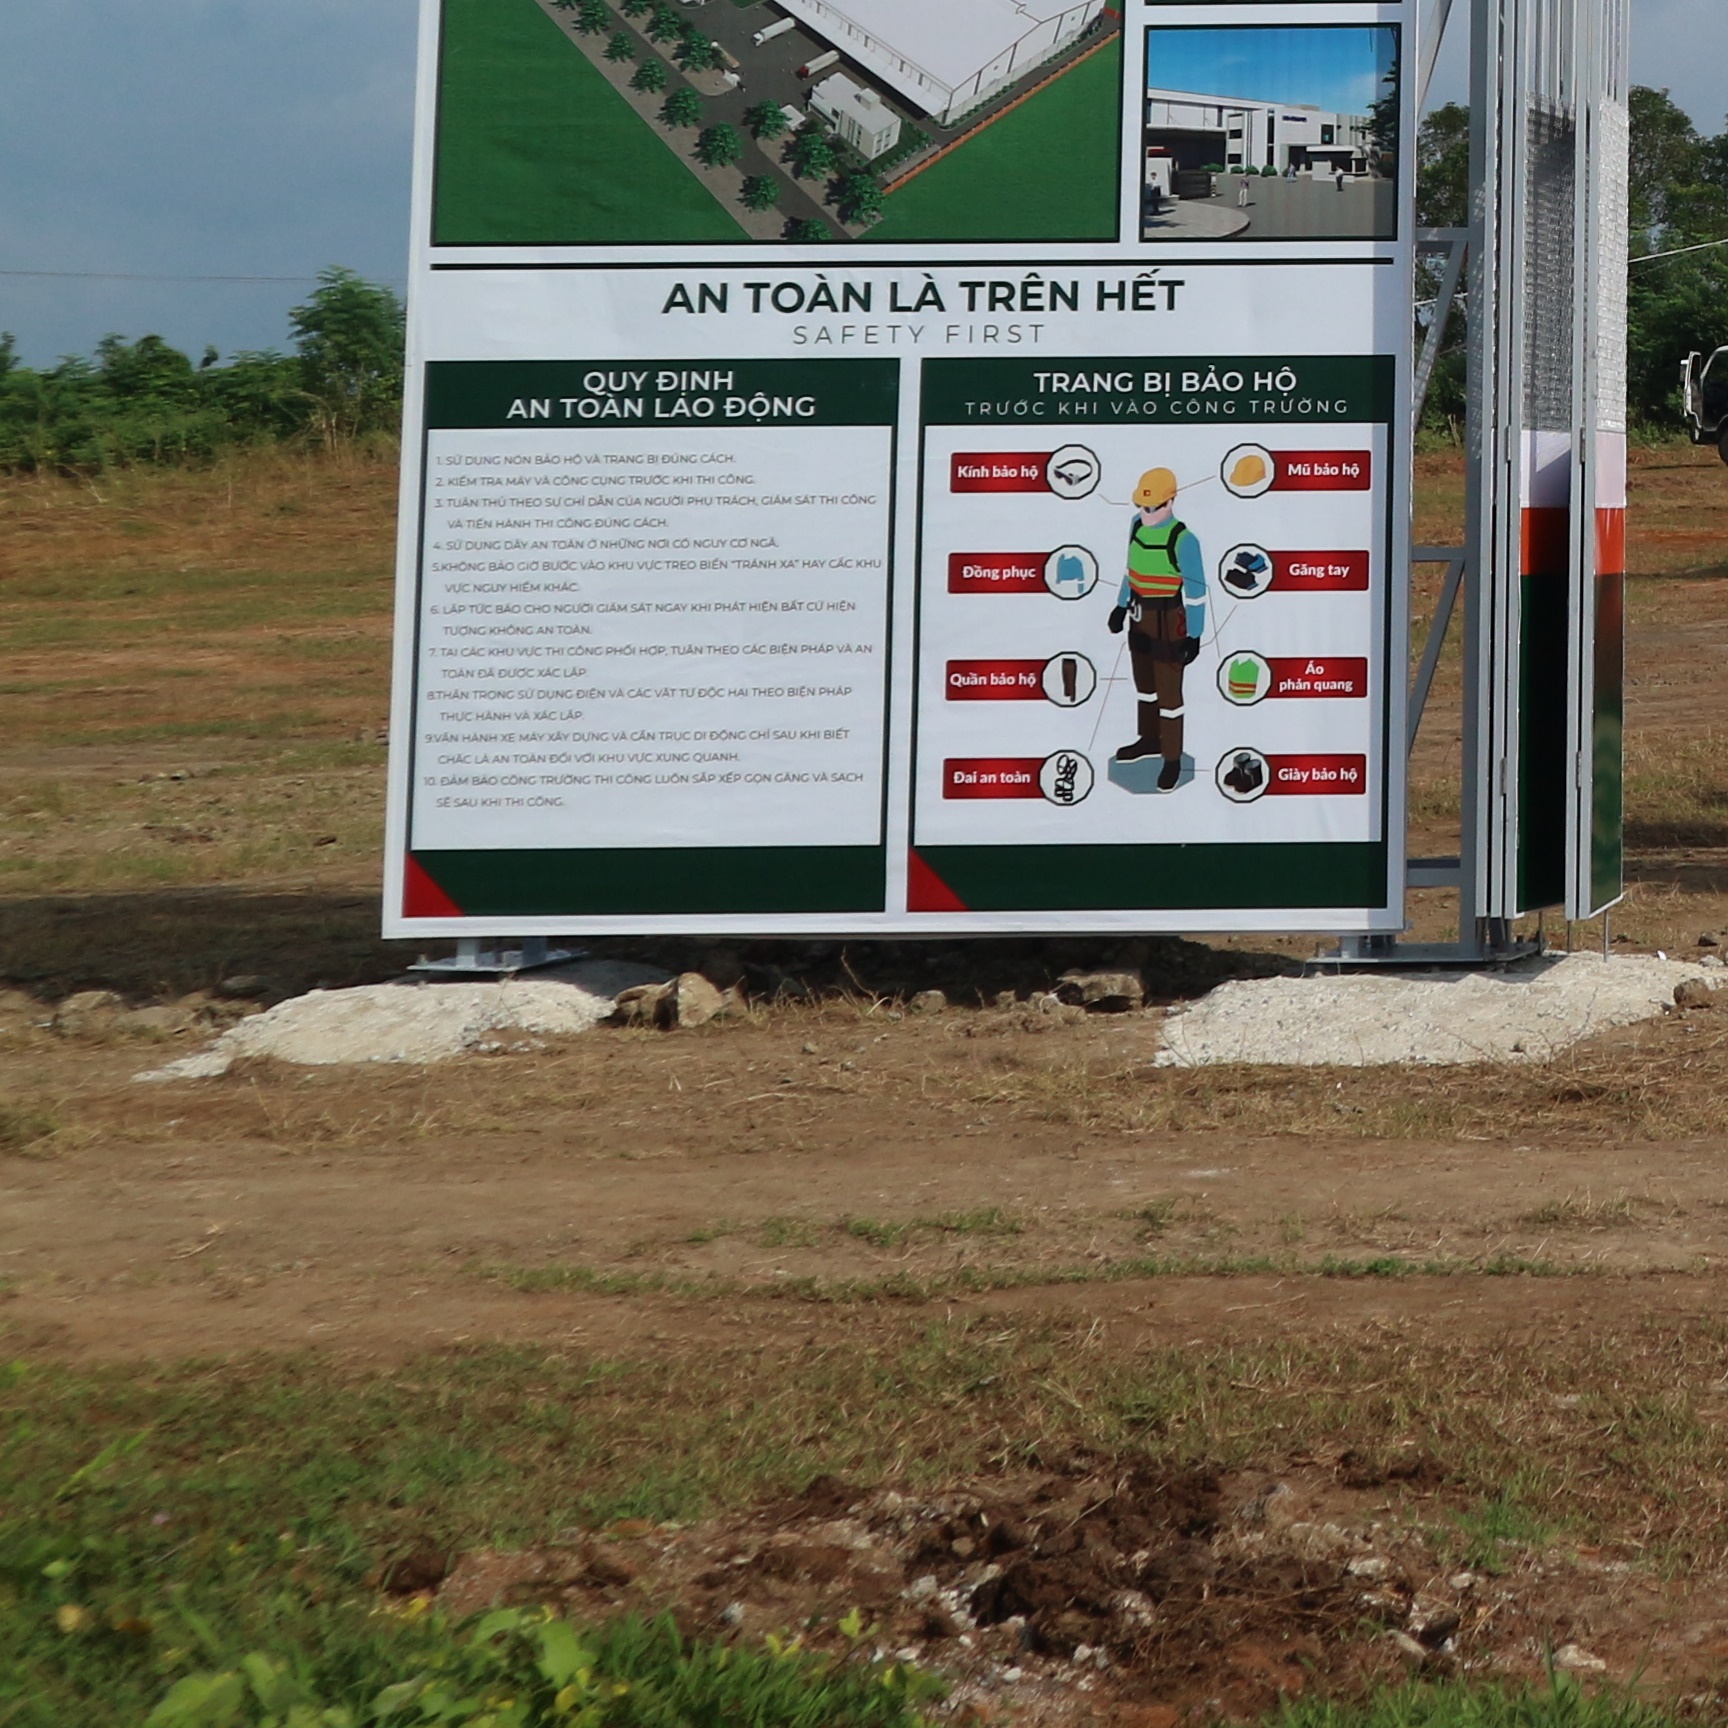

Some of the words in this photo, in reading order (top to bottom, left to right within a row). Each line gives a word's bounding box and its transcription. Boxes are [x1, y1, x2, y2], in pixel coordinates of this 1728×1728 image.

[662, 283, 727, 313] AN
[744, 274, 871, 313] TOÀN
[890, 273, 946, 312] LÀ
[959, 272, 1078, 312] TRÊN
[1097, 269, 1185, 311] HẾT
[793, 325, 924, 344] SAFETY
[946, 324, 1044, 343] FIRST
[584, 372, 648, 394] QUY
[656, 371, 733, 394] ĐỊNH
[1034, 373, 1133, 392] TRANG
[1144, 372, 1170, 396] BỊ
[1182, 365, 1243, 391] BẢO
[1254, 367, 1296, 395] HỘ
[507, 399, 550, 418] AN
[560, 395, 643, 418] TOÀN
[655, 398, 714, 417] LAO
[723, 397, 814, 422] ĐỘNG
[958, 466, 989, 477] Kính
[993, 465, 1017, 477] bảo
[1021, 466, 1038, 479] hộ
[1288, 464, 1310, 475] Mũ
[1314, 463, 1338, 475] bảo
[1343, 463, 1359, 477] hộ
[963, 565, 999, 580] Đồng
[1003, 566, 1035, 580] phục
[1290, 564, 1324, 578] Găng
[1328, 565, 1349, 577] tay
[1305, 661, 1324, 674] Áo
[1280, 678, 1310, 692] phản
[1314, 681, 1352, 692] quang
[1279, 768, 1309, 782] Giày
[1312, 768, 1336, 780] bảo
[1341, 768, 1357, 782] hộ
